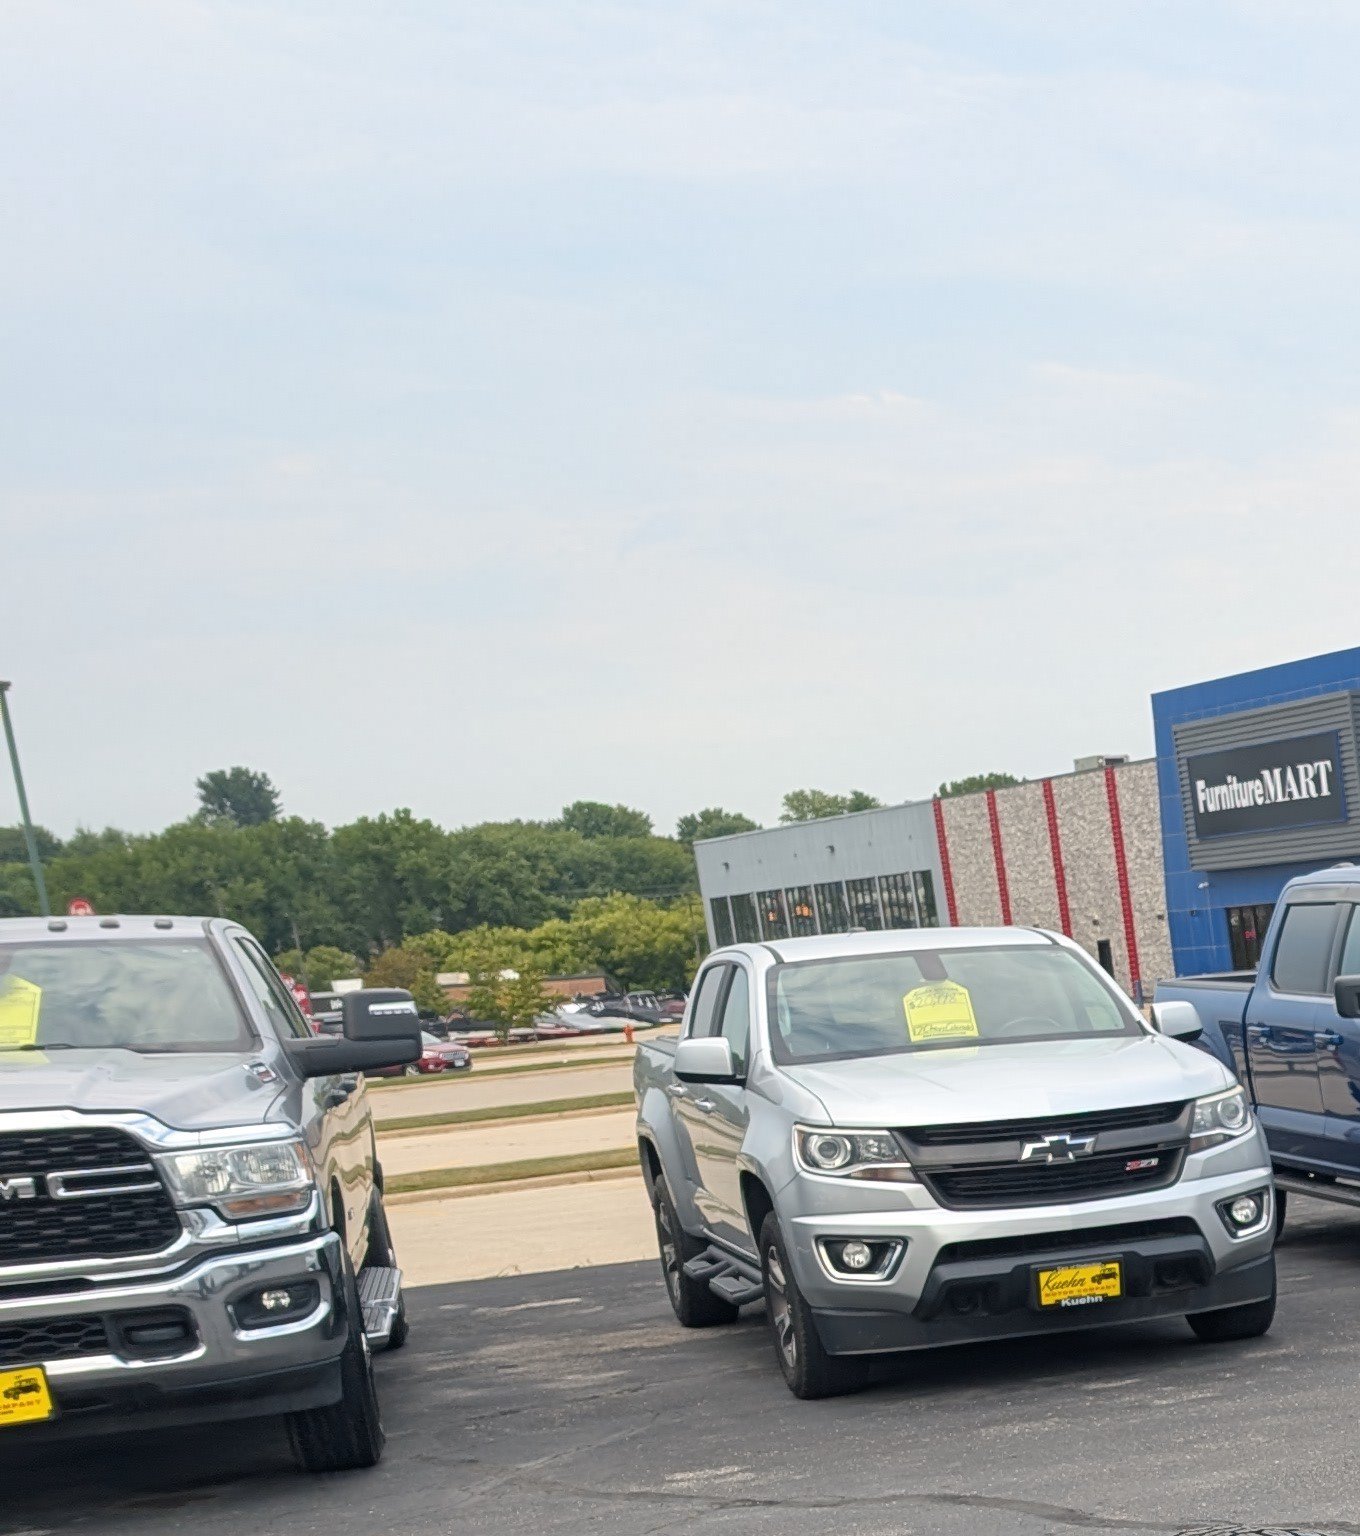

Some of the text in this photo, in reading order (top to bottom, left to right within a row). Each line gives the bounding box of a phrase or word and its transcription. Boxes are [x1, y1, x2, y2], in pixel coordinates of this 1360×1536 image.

[1194, 759, 1333, 814] FurnitureMART
[1041, 1270, 1087, 1293] Kuehn
[1060, 1295, 1104, 1308] Kuehn
